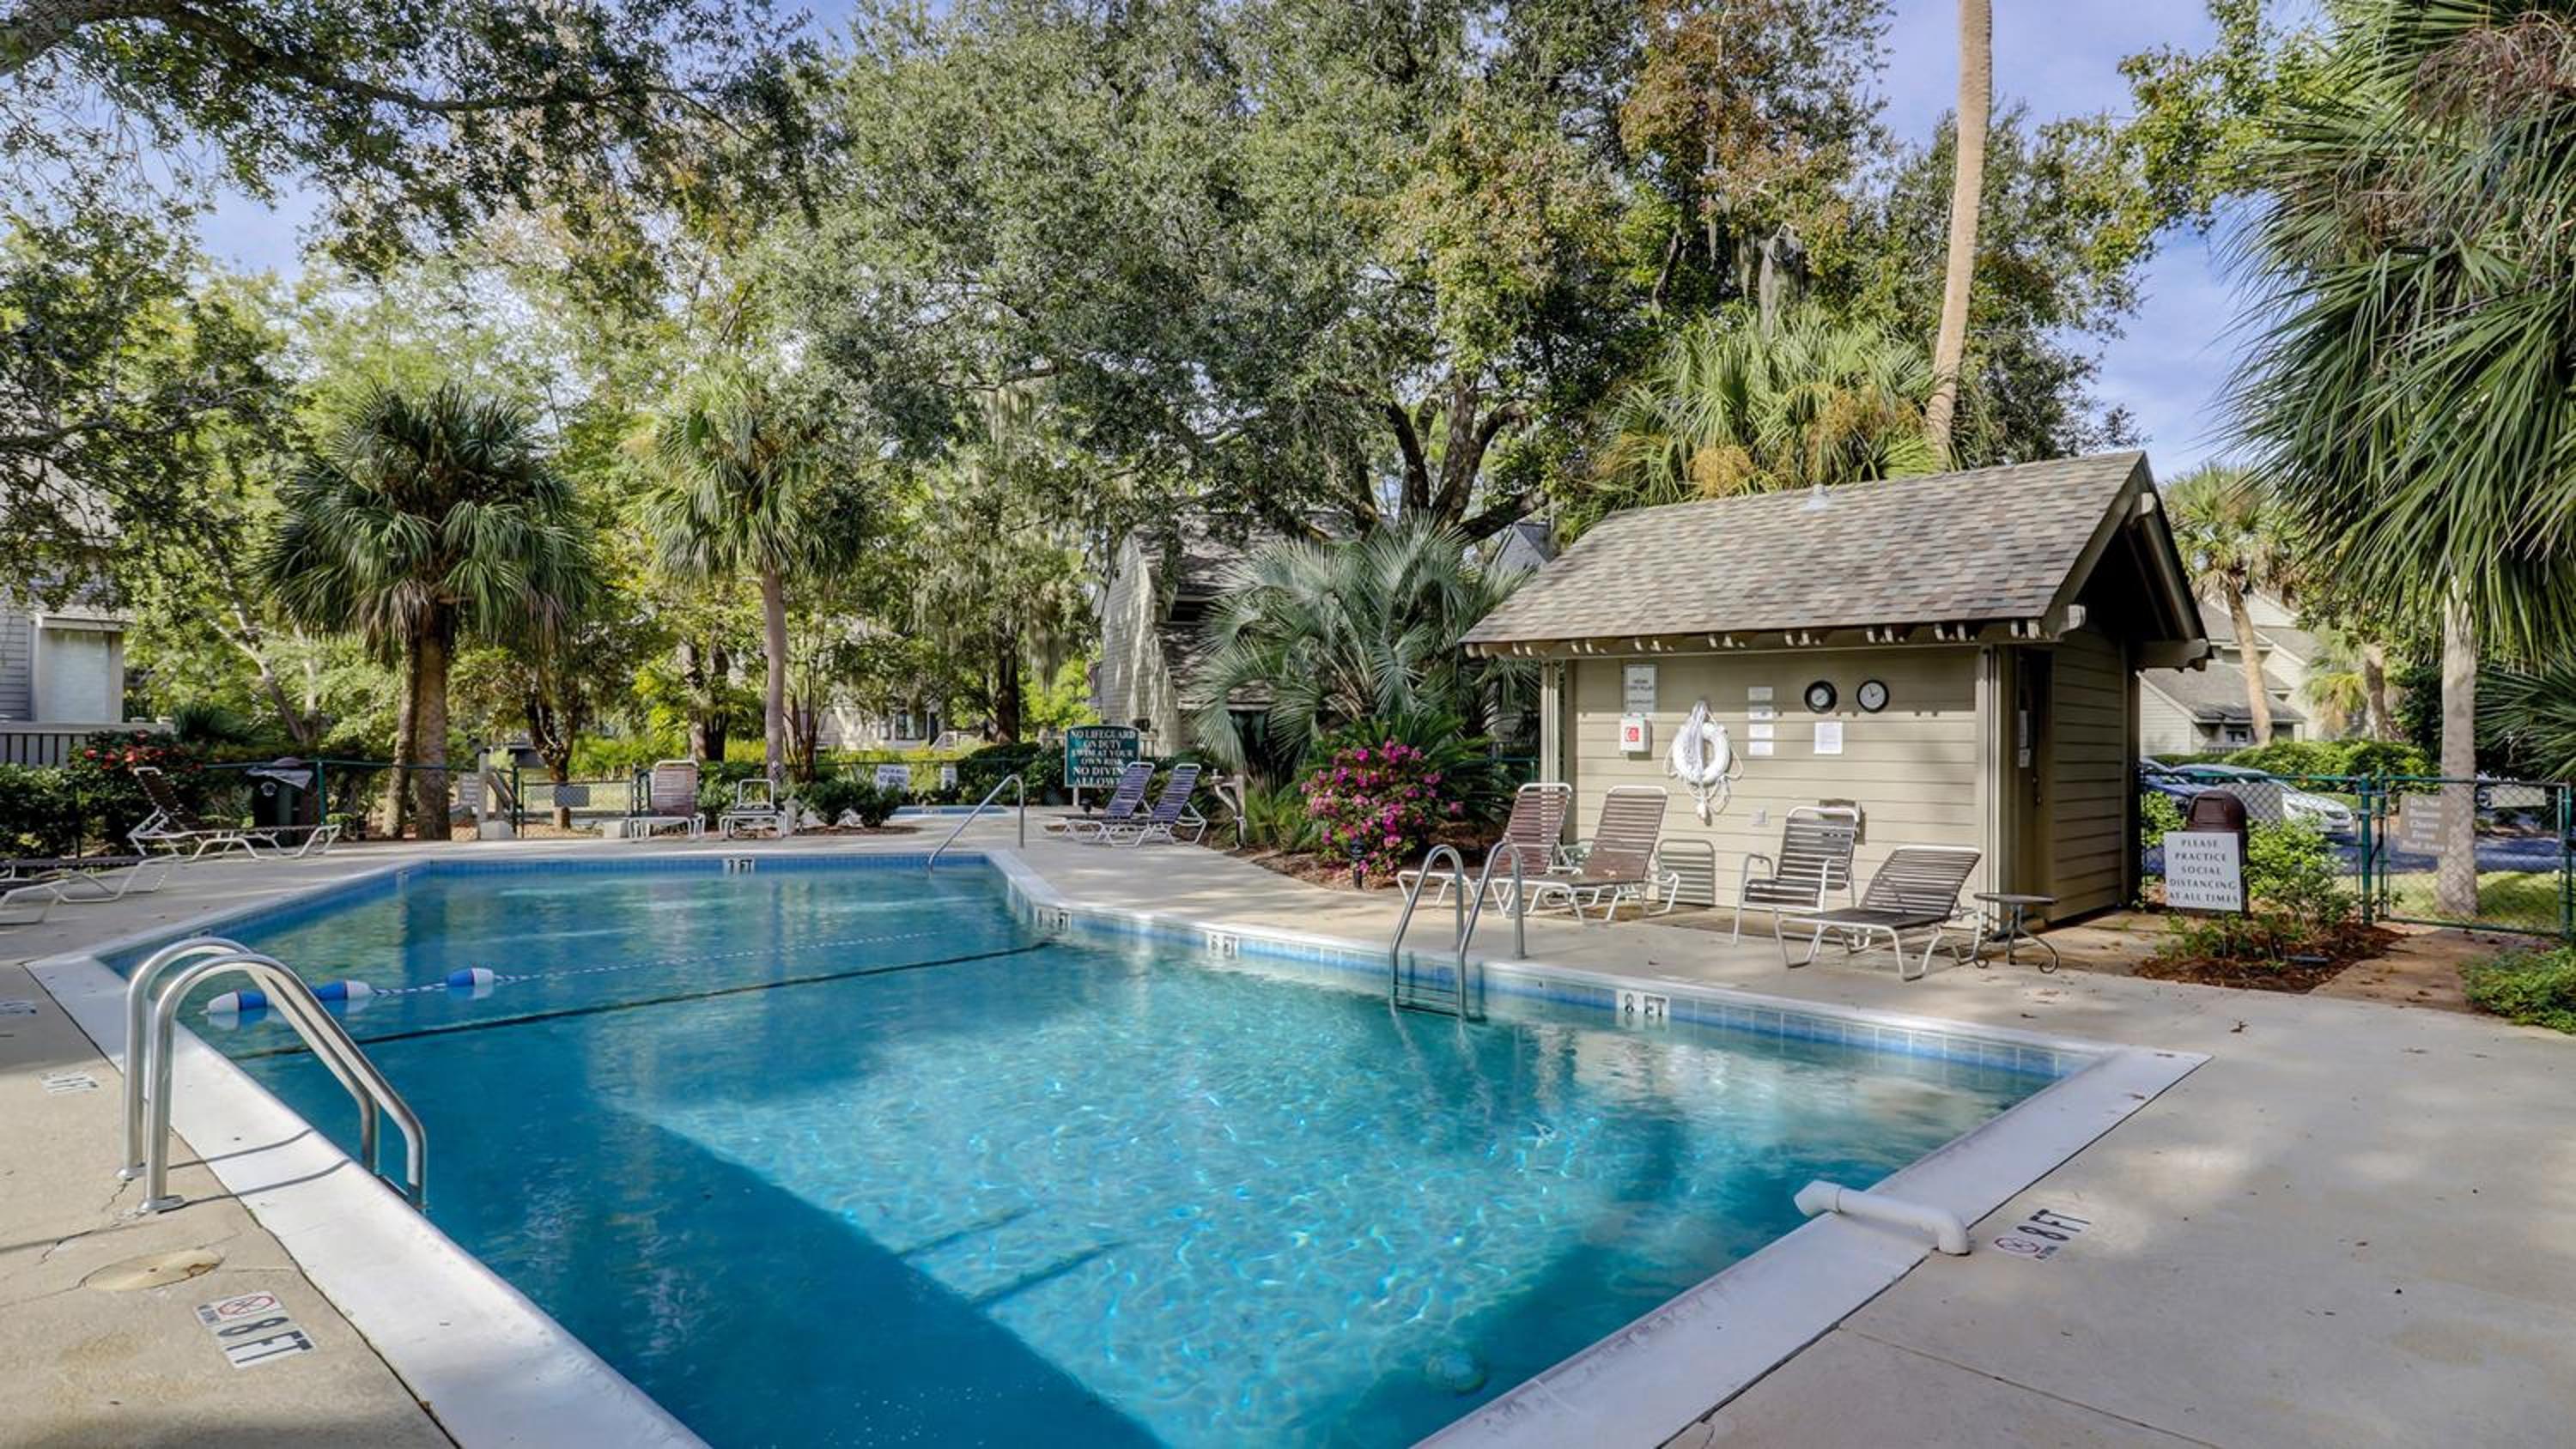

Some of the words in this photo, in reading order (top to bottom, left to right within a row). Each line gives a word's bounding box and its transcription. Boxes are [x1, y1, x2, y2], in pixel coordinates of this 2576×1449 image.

[1071, 730, 1084, 738] NO
[1072, 767, 1089, 775] NO
[1091, 767, 1126, 775] DIVIN
[2181, 839, 2218, 848] PLEASE
[2174, 852, 2226, 862] PRACTICE
[2181, 865, 2221, 875] SOCIAL
[2169, 878, 2237, 890] DISTANCING
[2184, 892, 2202, 901] ALL
[2205, 894, 2239, 904] TIMES
[1625, 993, 1635, 1015] 8
[1643, 995, 1667, 1016] FT
